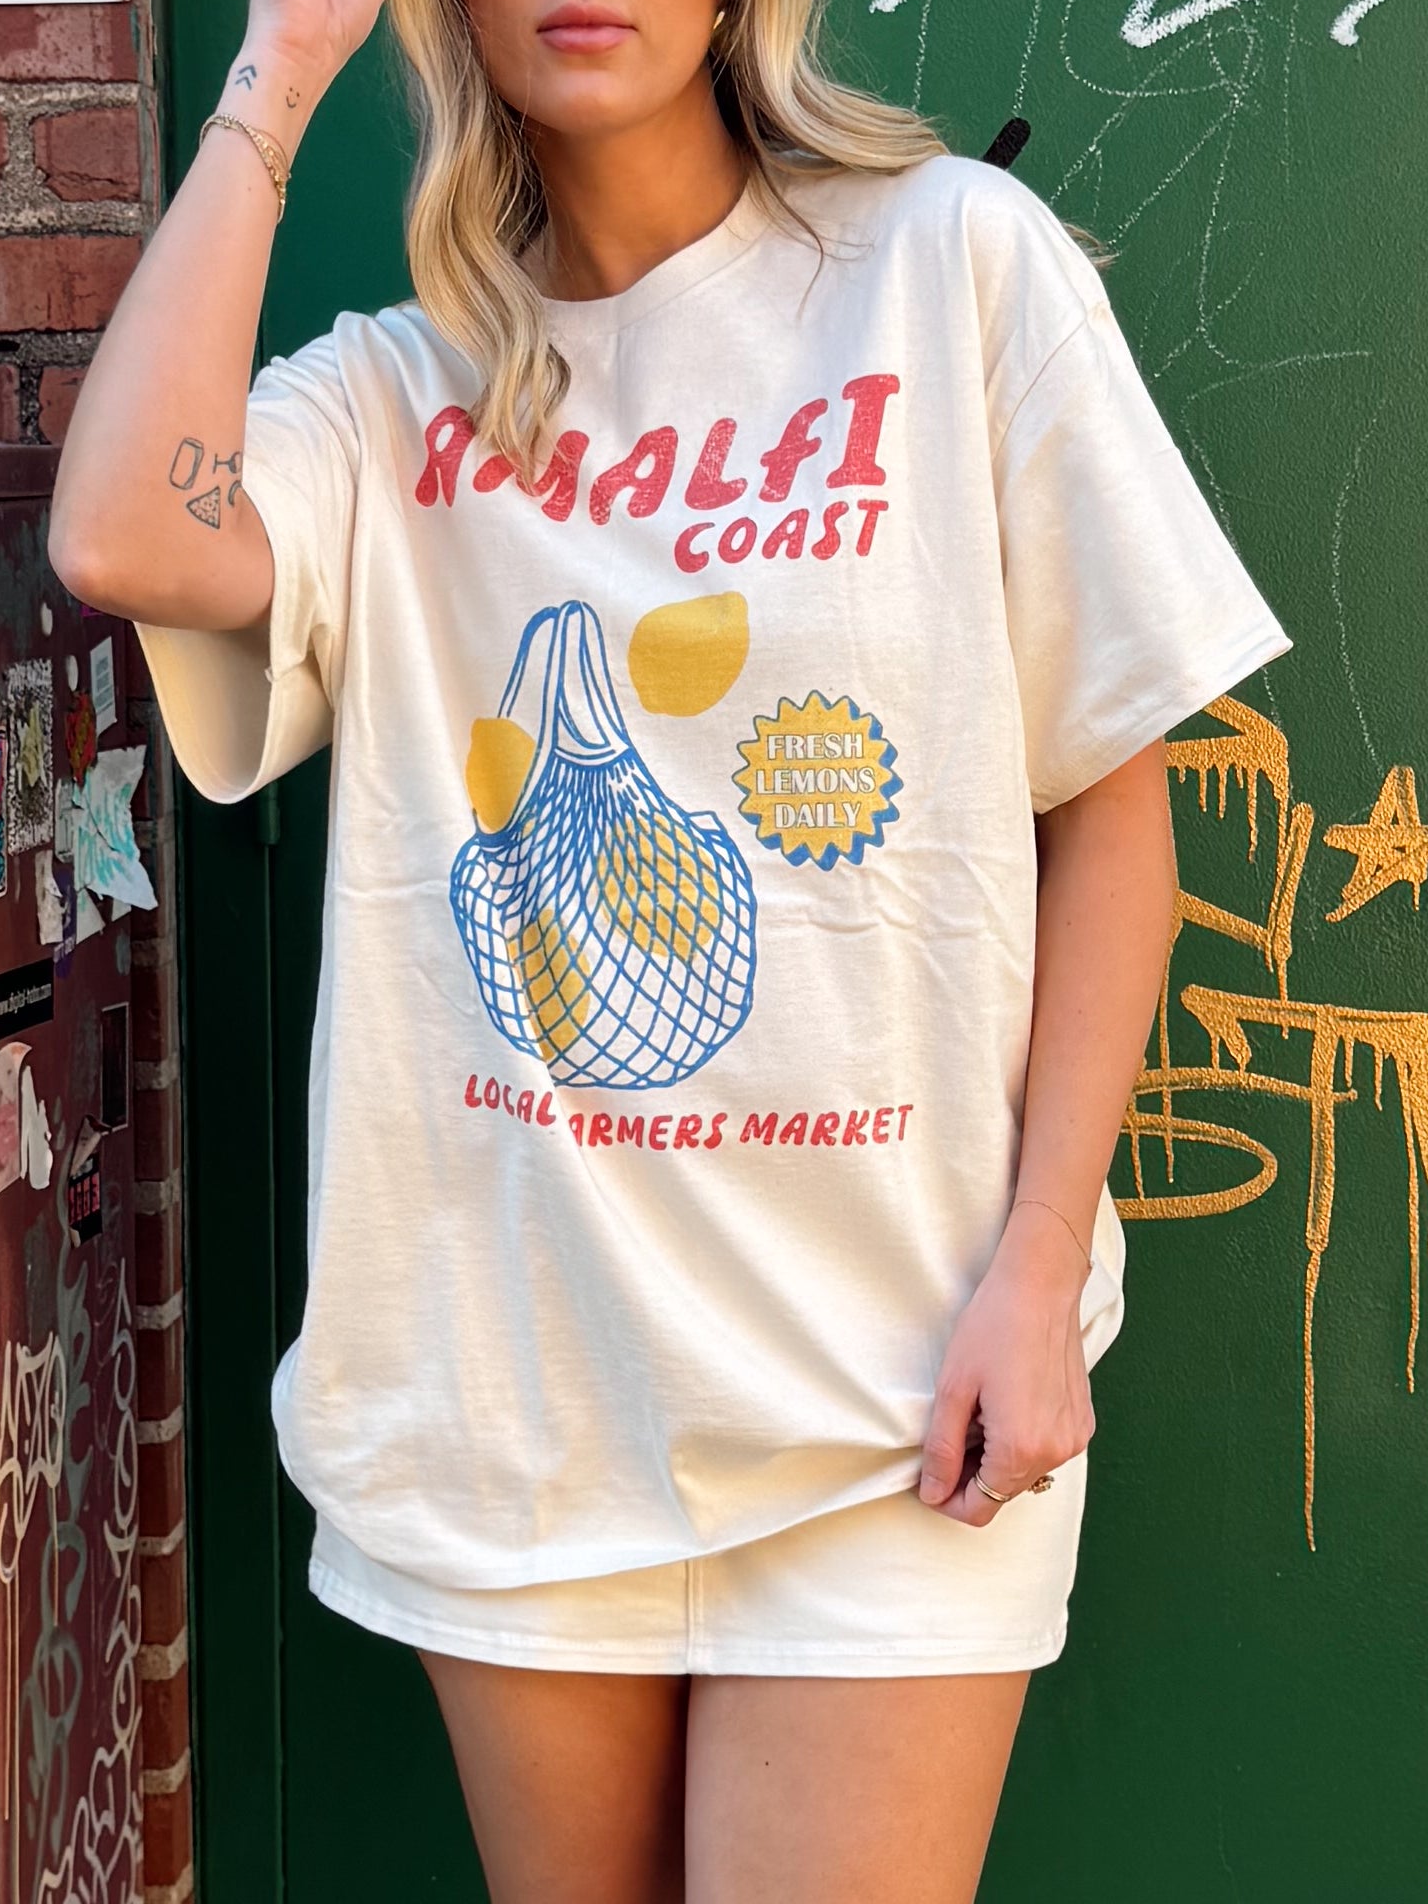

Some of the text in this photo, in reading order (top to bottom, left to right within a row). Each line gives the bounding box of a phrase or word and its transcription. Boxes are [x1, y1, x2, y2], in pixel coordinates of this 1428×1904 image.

[673, 498, 891, 574] COAST
[767, 731, 864, 761] FRESH
[755, 765, 877, 795] LEMONS
[774, 801, 862, 829] DAILY
[464, 1073, 916, 1153] LOCAL ARMERS MARKET
